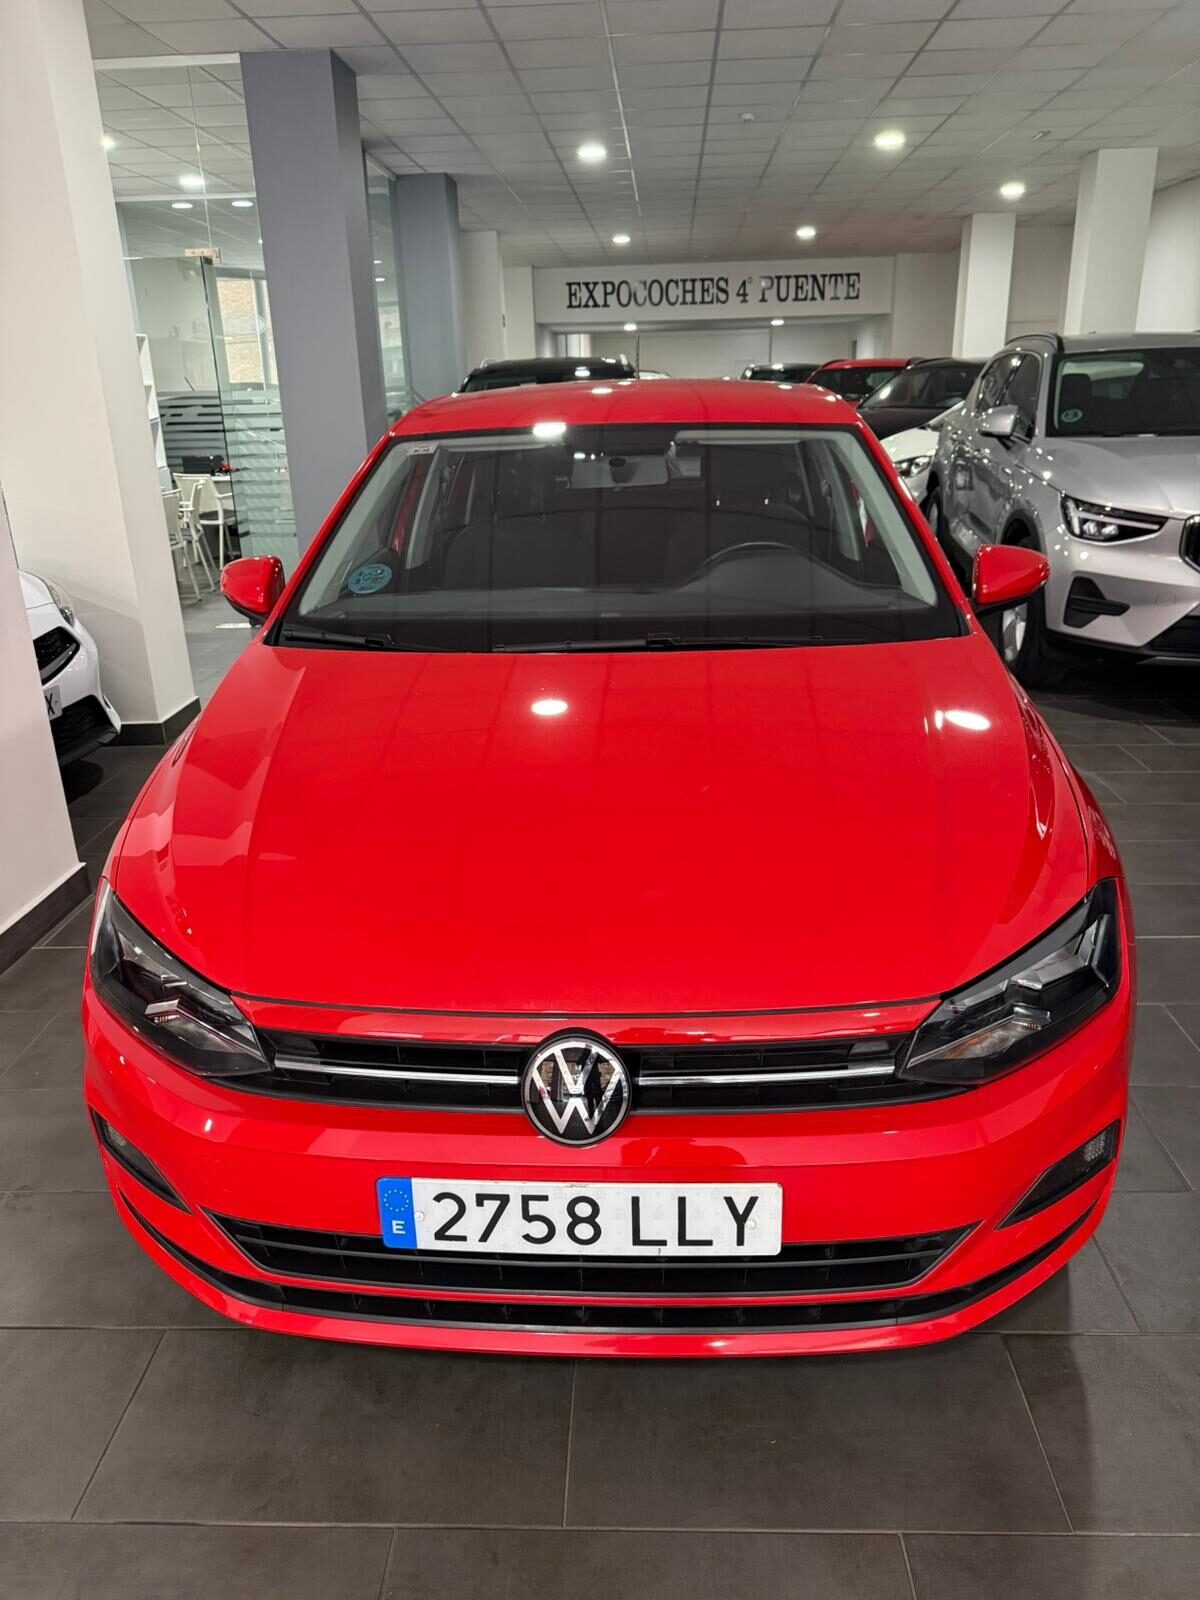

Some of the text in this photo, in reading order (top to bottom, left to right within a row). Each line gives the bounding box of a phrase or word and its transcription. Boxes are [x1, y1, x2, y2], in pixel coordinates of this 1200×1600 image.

[566, 277, 729, 309] EXPOCOCHES
[758, 272, 861, 303] PUENTE
[391, 1219, 406, 1235] E
[432, 1191, 759, 1247] 2758 LLY
